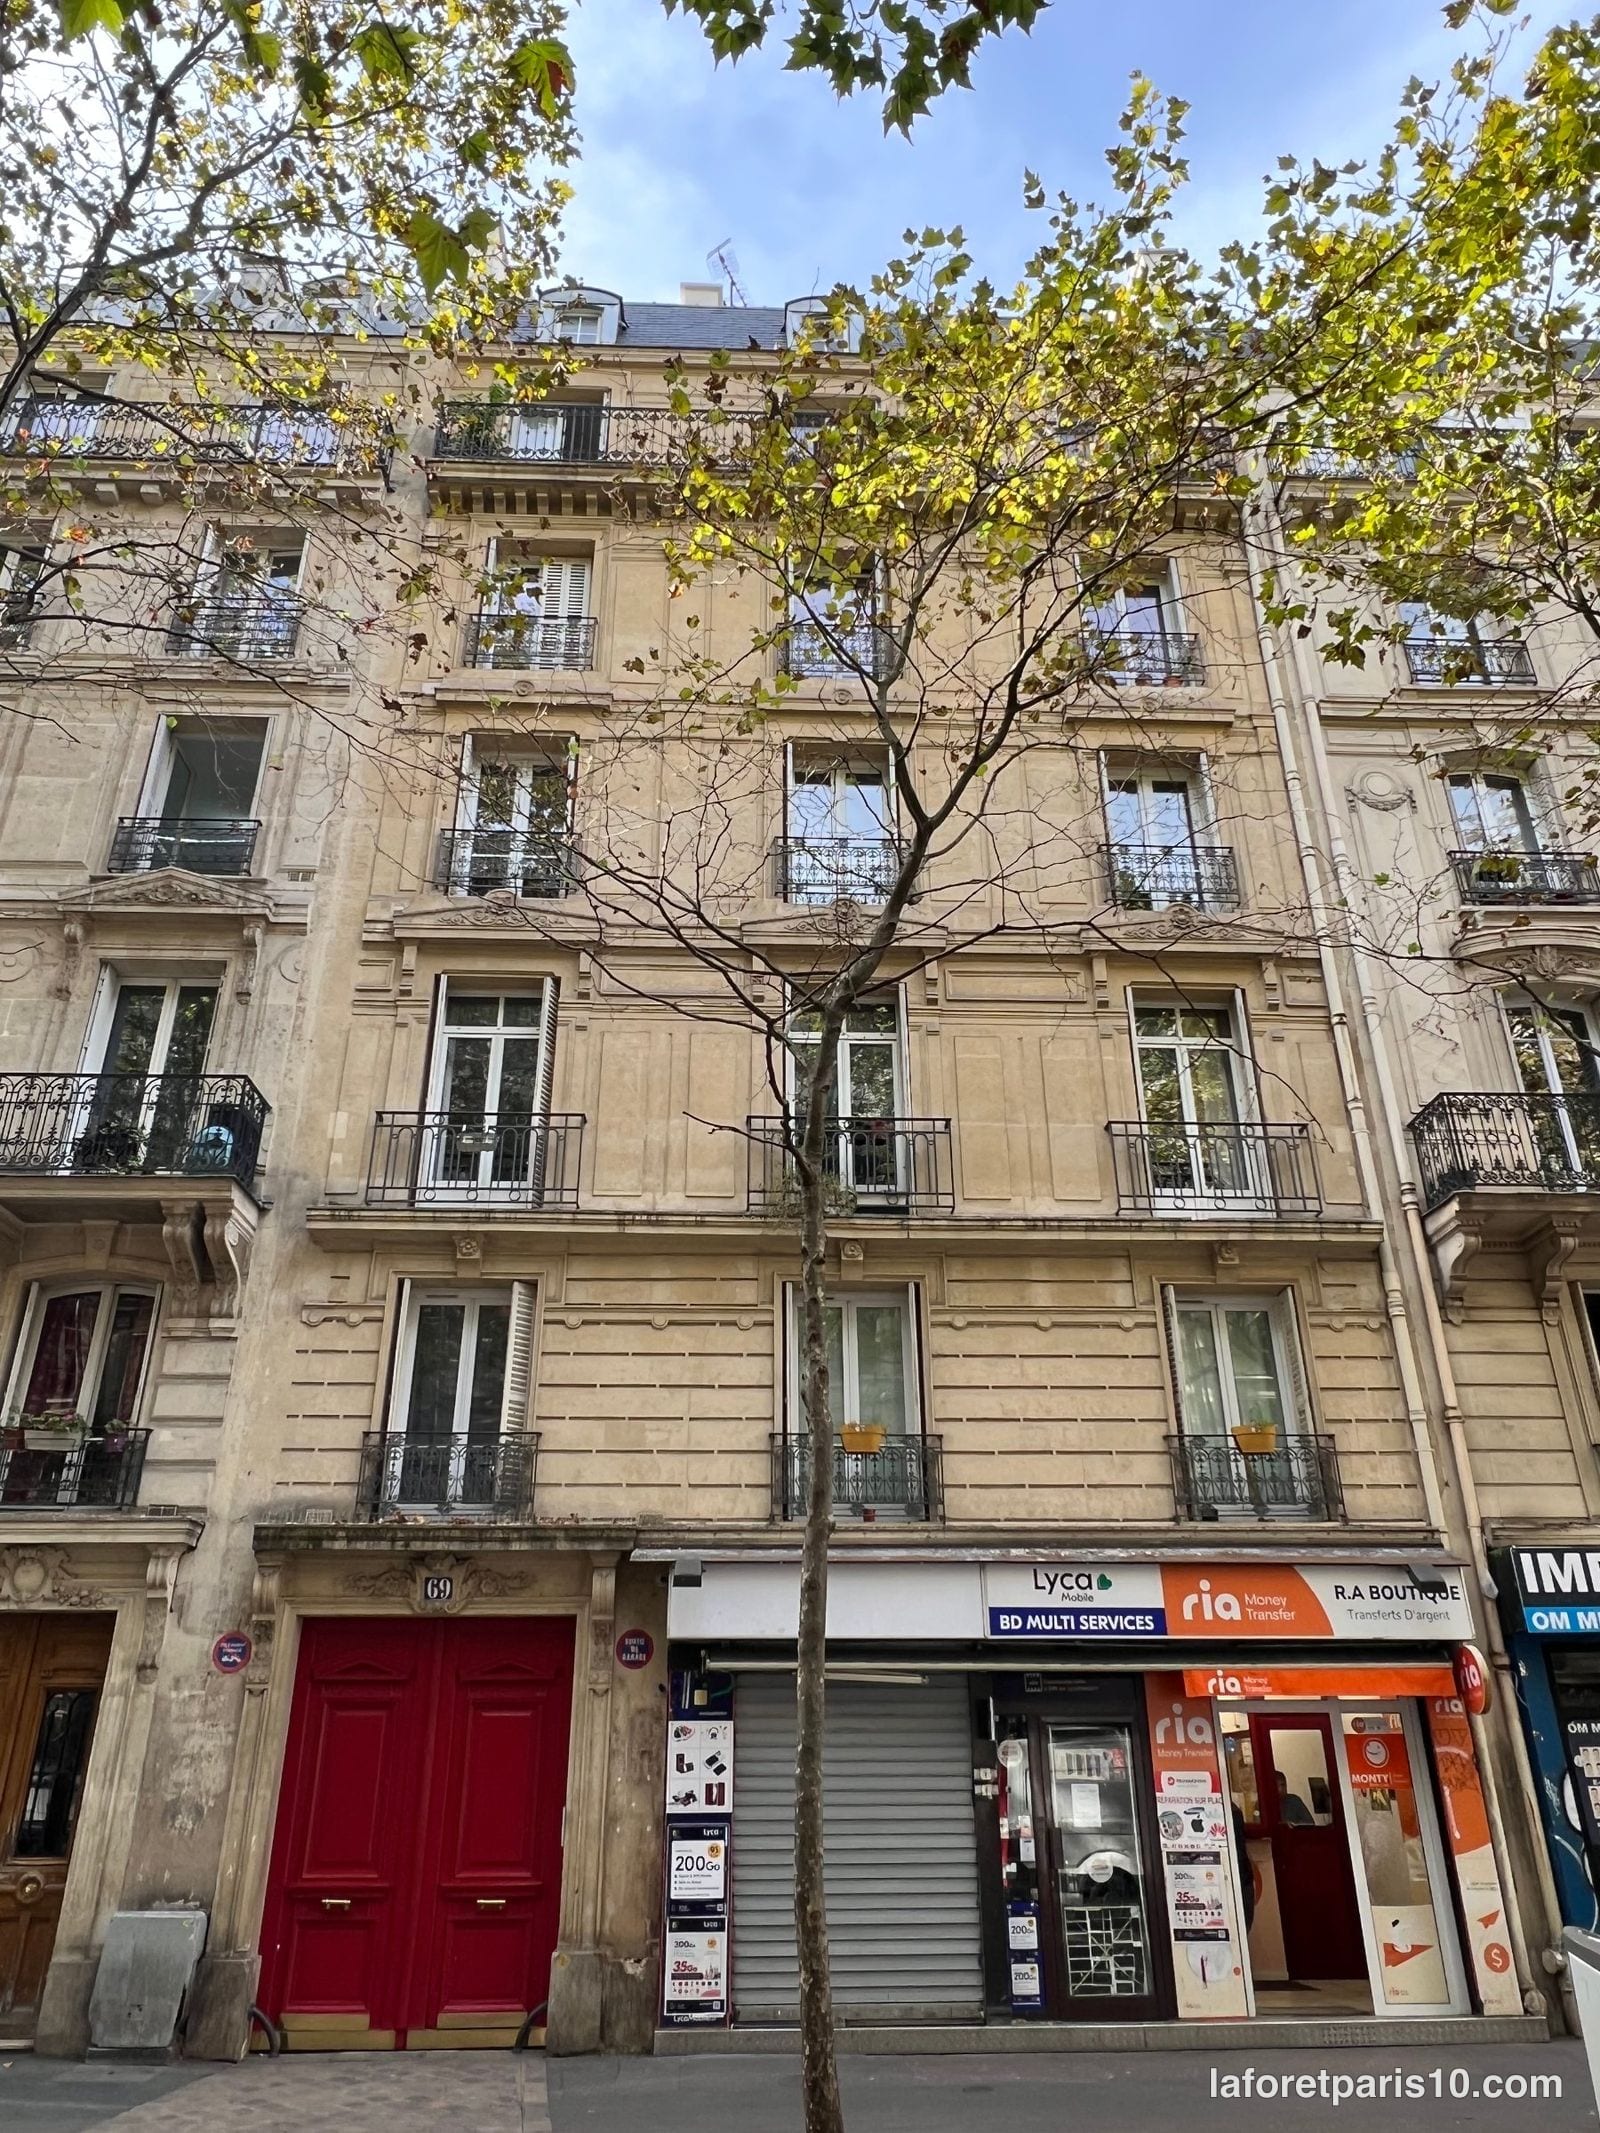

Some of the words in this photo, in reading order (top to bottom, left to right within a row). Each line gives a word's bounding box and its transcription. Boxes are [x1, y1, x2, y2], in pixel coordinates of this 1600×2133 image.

[427, 1578, 451, 1600] 69
[1033, 1568, 1093, 1595] Lyca
[1061, 1592, 1094, 1602] Mobile
[1183, 1579, 1241, 1621] ria
[1244, 1593, 1287, 1607] Money
[1334, 1585, 1365, 1600] R.A
[1000, 1614, 1022, 1630] BD
[1027, 1614, 1075, 1630] MULTI
[1080, 1615, 1154, 1630] SERVICES
[1247, 1608, 1296, 1621] Transfer
[1347, 1609, 1401, 1621] Transferts
[1404, 1609, 1451, 1623] D'argent
[1532, 1612, 1571, 1629] OM
[1577, 1612, 1600, 1629] M
[1207, 1669, 1241, 1694] ria
[1155, 1703, 1213, 1744] ria
[1351, 1773, 1389, 1784] MONTY
[675, 1856, 721, 1872] 200Go
